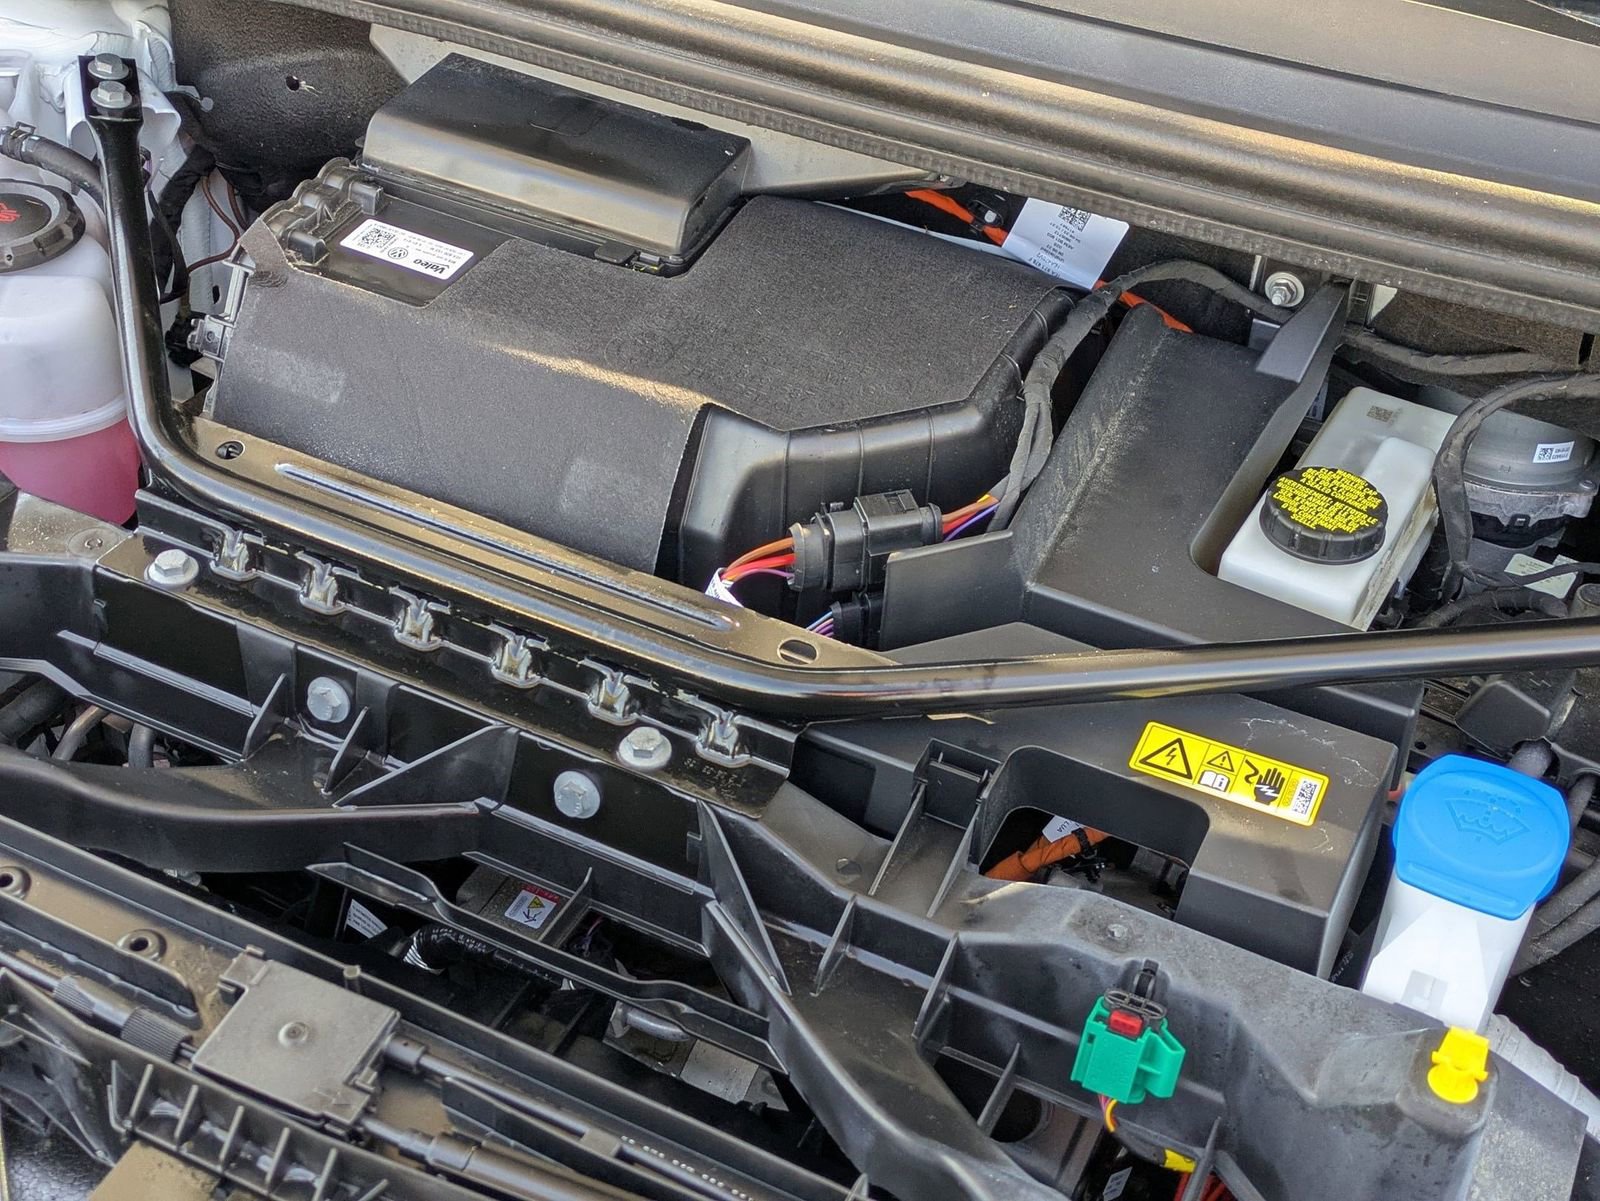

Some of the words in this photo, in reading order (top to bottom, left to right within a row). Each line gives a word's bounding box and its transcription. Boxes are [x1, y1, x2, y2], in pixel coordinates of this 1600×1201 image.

[413, 257, 446, 274] Valeo
[1301, 472, 1321, 483] ONLY
[1337, 489, 1358, 500] FLUID
[1357, 498, 1378, 509] FROM
[1305, 481, 1331, 494] SEALED
[1306, 468, 1333, 483] BEFORE
[1367, 496, 1382, 504] USE
[1320, 468, 1342, 480] CLEAN
[1340, 478, 1364, 490] FILLER
[1363, 488, 1378, 496] CAP
[1276, 482, 1309, 498] BOUCHON
[1307, 497, 1330, 508] AVANT
[1338, 510, 1349, 518] LE
[1273, 493, 1300, 507] LIQUIDE
[1316, 513, 1356, 533] PROVENANT
[1298, 511, 1337, 531] CONTENANT
[1334, 502, 1368, 520] NETTOYER
[1367, 517, 1378, 525] LE
[1334, 515, 1350, 524] QUE
